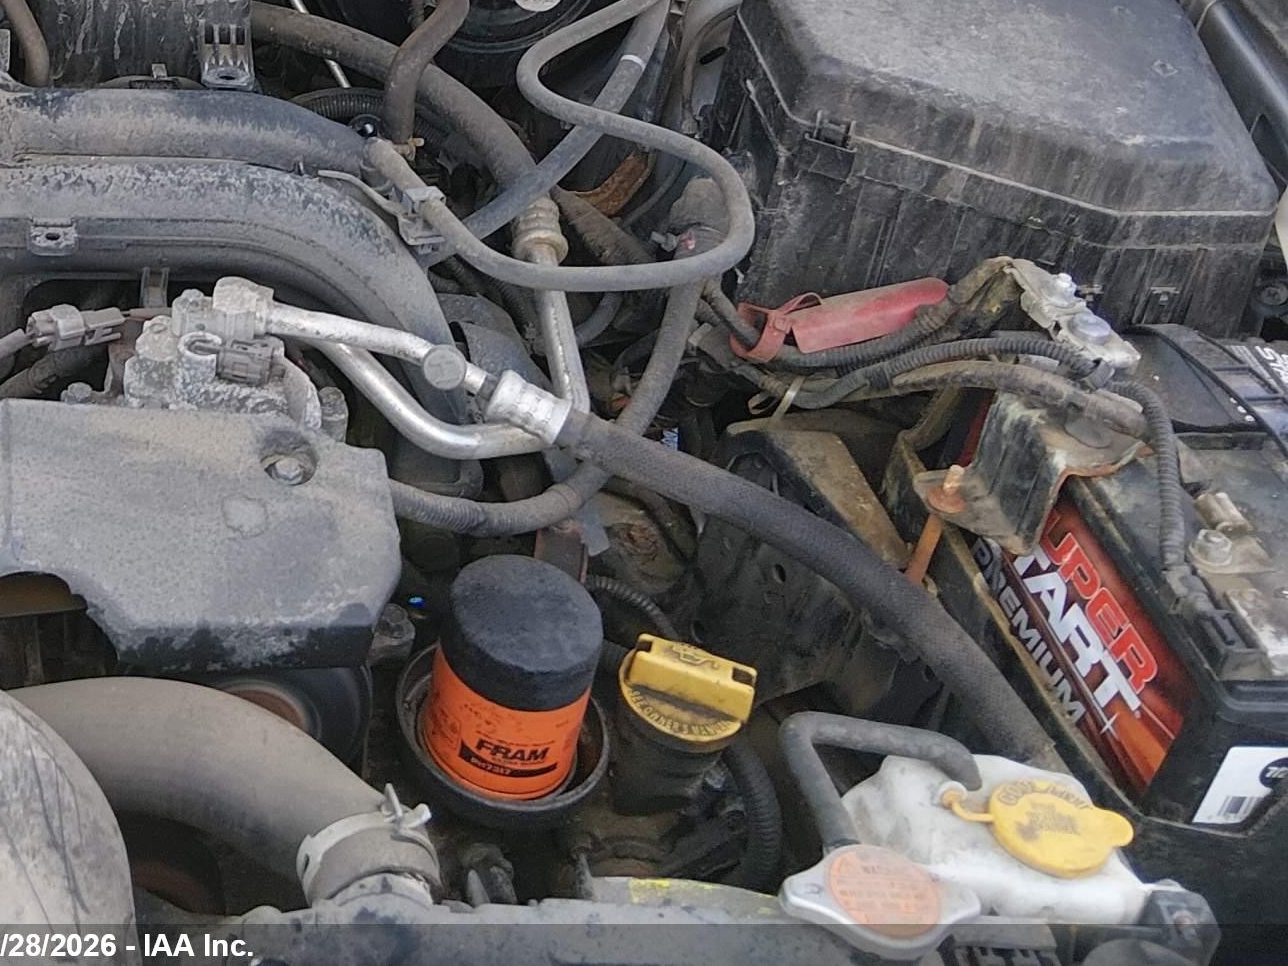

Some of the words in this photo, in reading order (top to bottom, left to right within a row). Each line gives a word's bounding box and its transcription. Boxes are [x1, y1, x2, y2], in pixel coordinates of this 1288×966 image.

[975, 537, 1086, 724] PREMIUM
[1014, 545, 1141, 711] TART
[1039, 510, 1158, 694] UPER
[476, 738, 550, 761] FRAM
